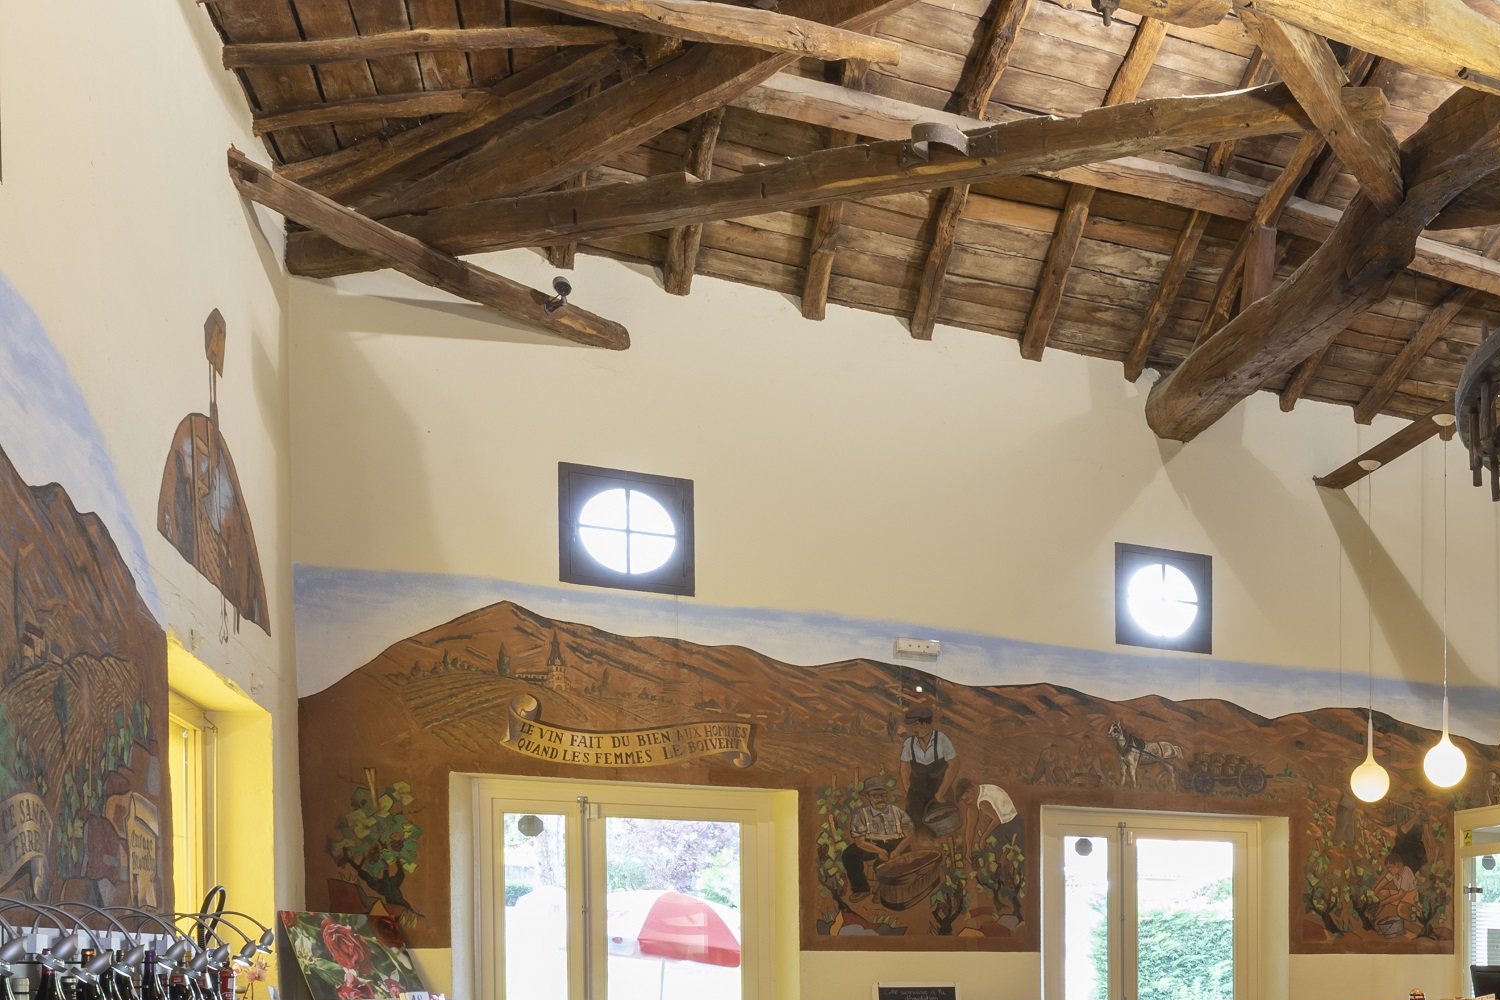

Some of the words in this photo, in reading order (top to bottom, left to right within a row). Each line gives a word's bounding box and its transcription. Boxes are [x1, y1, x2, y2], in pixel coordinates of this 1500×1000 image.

[520, 722, 535, 736] LE
[538, 727, 564, 744] VIN
[569, 735, 603, 749] FAIT
[611, 735, 630, 748] DU
[636, 731, 671, 747] BIEN
[676, 726, 702, 741] AUX
[704, 725, 748, 738] HOMMES
[517, 738, 559, 760] QUAND
[562, 750, 591, 764] LES
[595, 750, 653, 764] FEMMES
[662, 743, 683, 760] LE
[687, 739, 742, 754] BOIVENT
